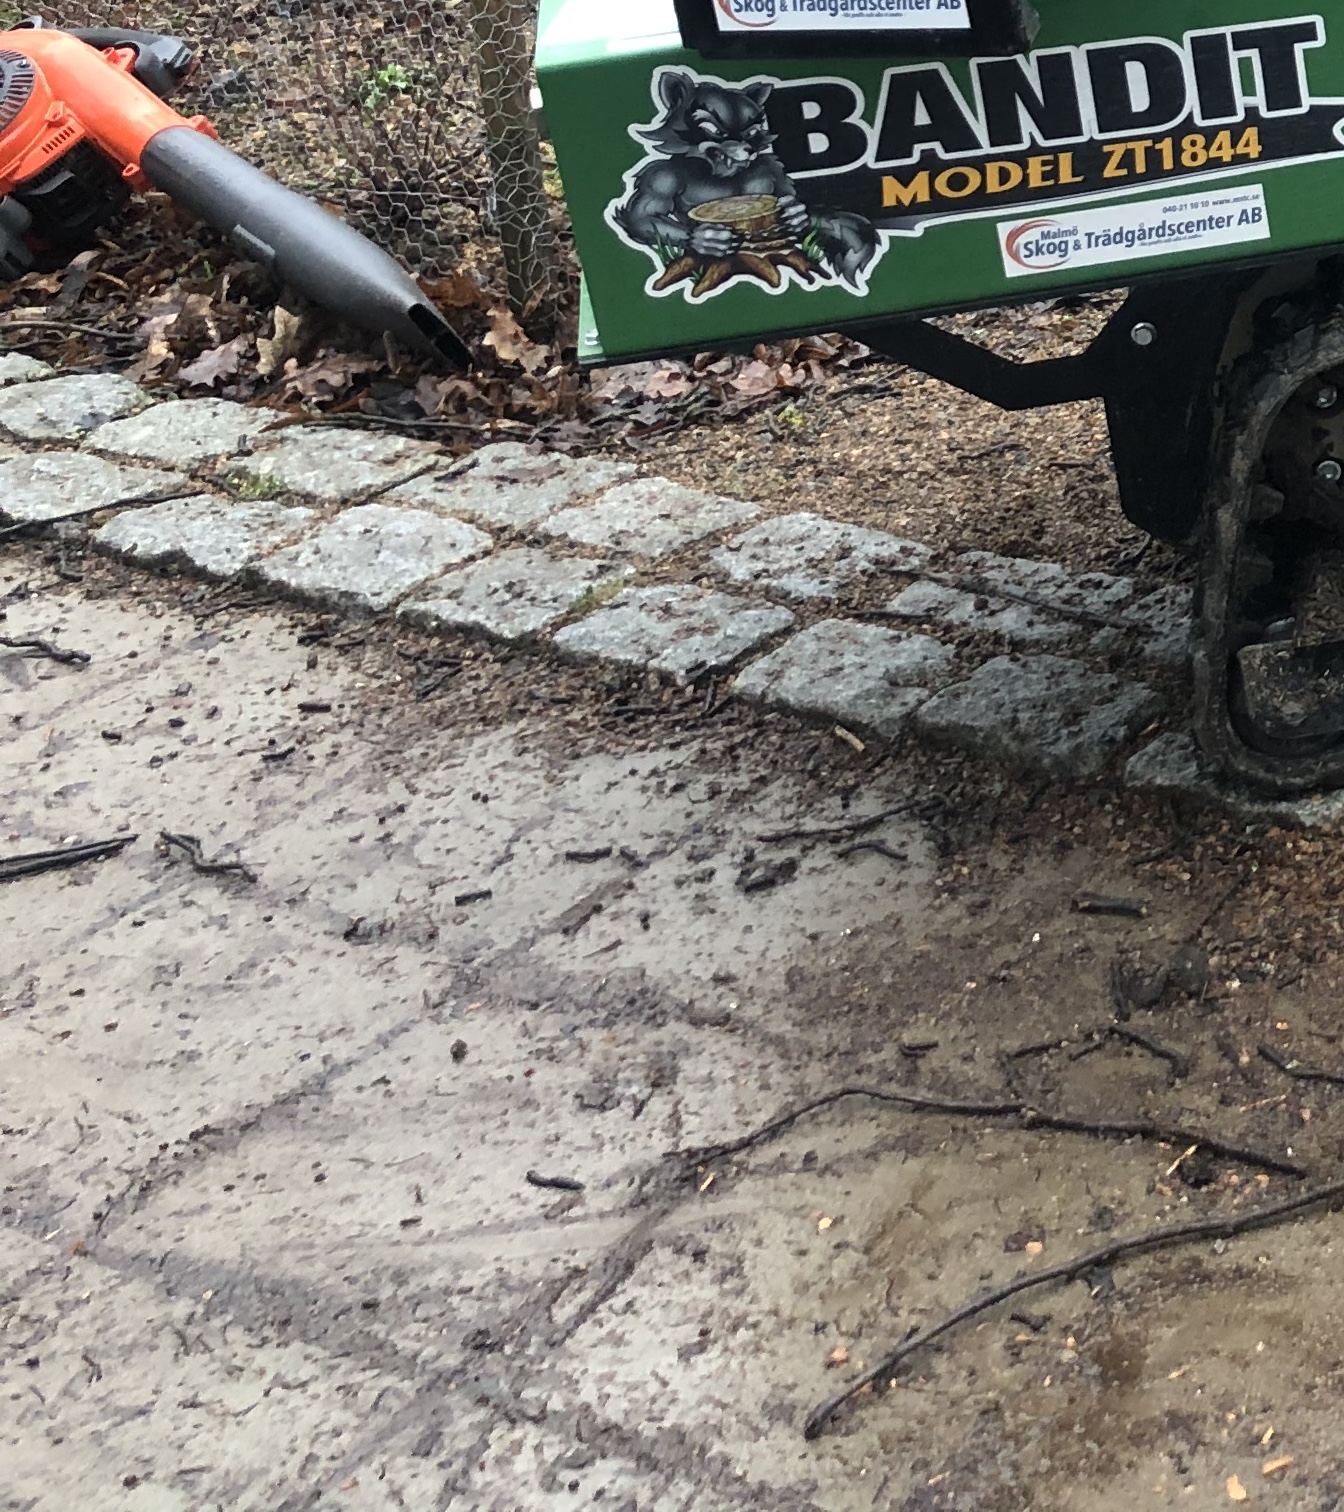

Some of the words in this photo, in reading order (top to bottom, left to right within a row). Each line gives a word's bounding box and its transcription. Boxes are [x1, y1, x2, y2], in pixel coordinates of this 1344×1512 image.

[780, 2, 788, 12] &
[767, 21, 1319, 173] BANDIT
[881, 152, 1084, 207] MODEL
[1102, 126, 1263, 179] ZT1844
[1023, 238, 1069, 259] Skog
[1073, 240, 1081, 251] &
[1085, 213, 1234, 249] Trädgårdscenter
[1237, 206, 1262, 226] AB
[1040, 225, 1078, 241] Malmö
